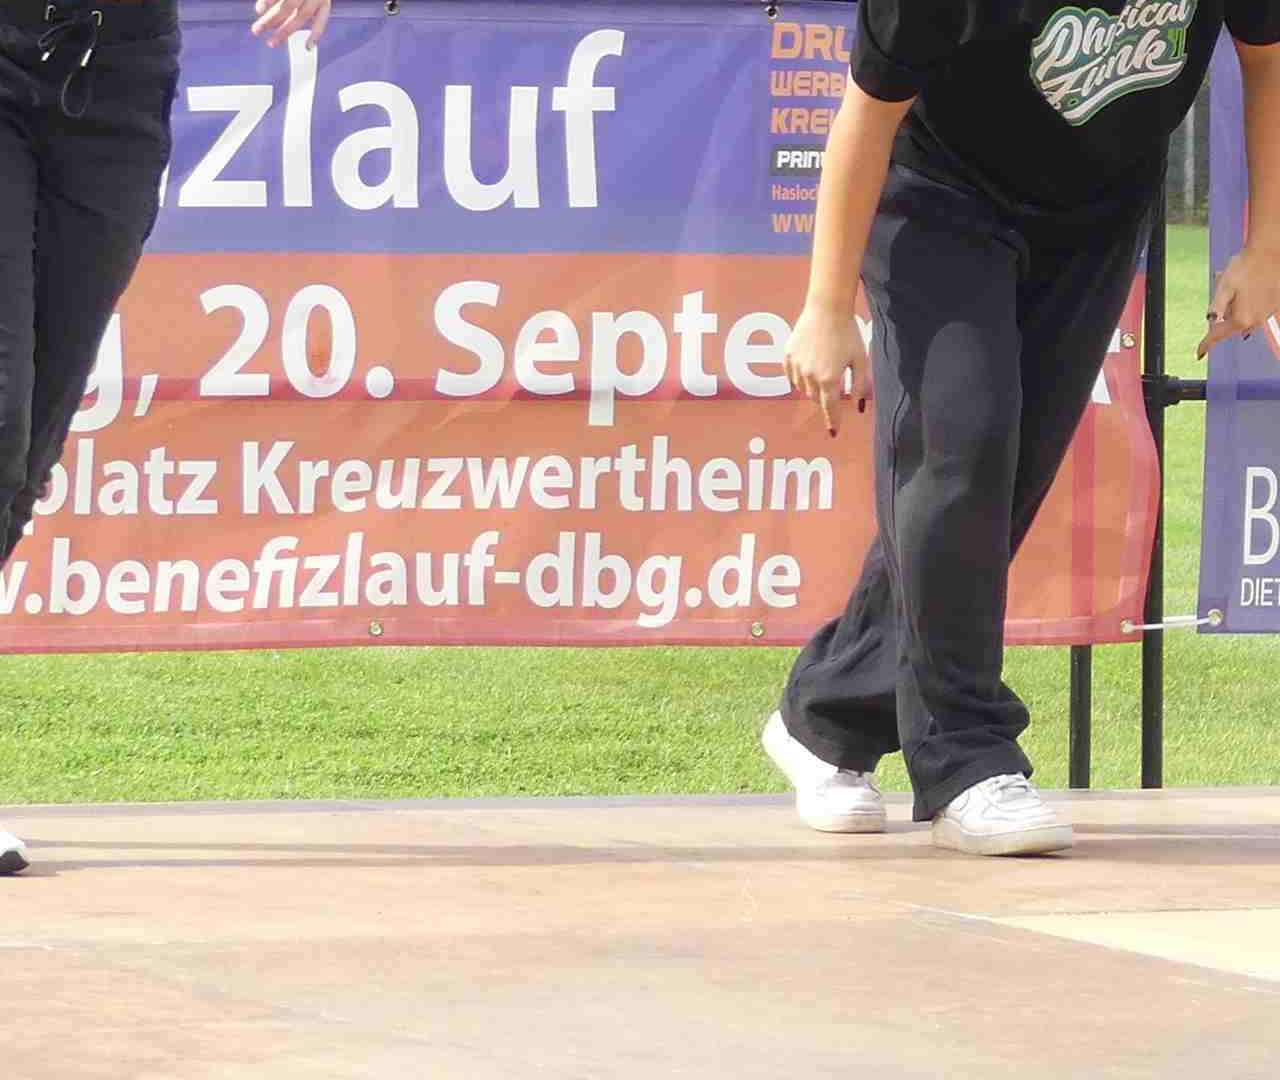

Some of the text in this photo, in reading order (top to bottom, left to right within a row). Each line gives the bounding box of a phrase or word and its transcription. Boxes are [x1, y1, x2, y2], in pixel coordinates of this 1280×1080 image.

[159, 29, 625, 212] zlauf
[199, 283, 394, 398] 20.
[242, 434, 834, 515] Kreuzwertheim
